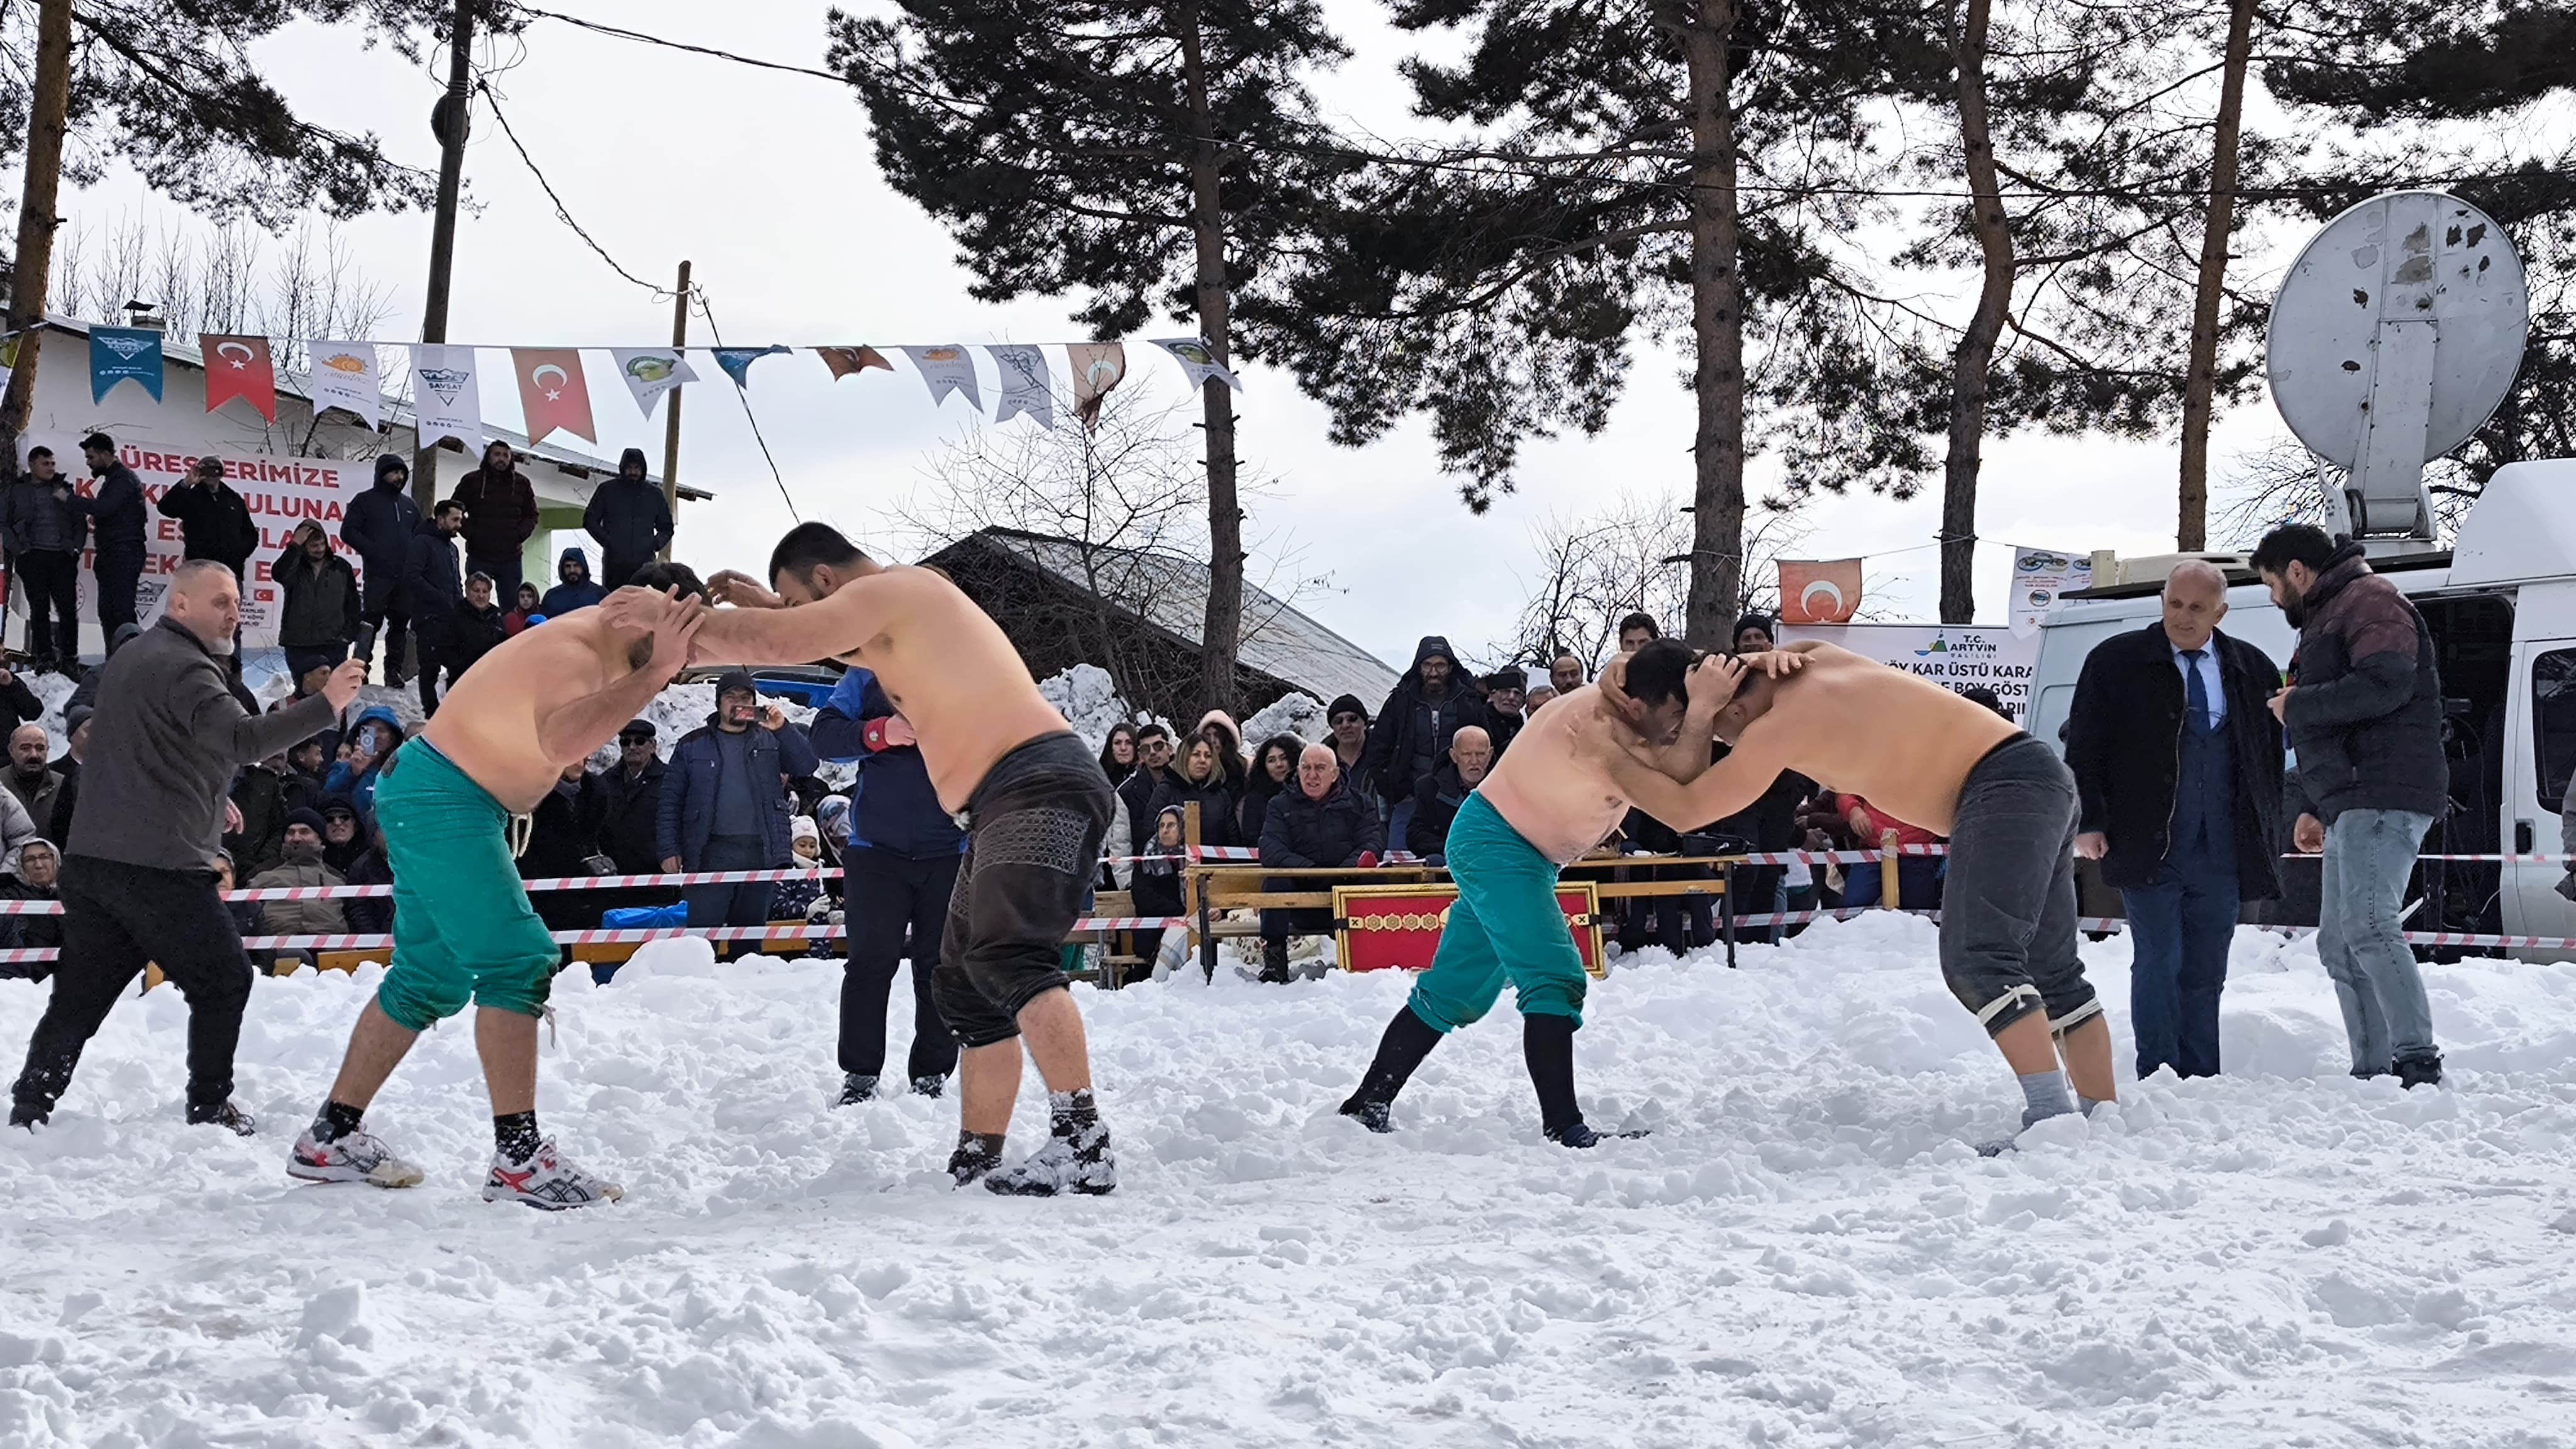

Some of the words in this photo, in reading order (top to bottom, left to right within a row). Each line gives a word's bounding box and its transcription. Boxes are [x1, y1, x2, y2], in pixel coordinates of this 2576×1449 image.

[243, 492, 344, 522] ULUNA
[1963, 635, 1985, 643] T.C.
[1913, 663, 1945, 676] KAR
[1948, 661, 1989, 677] ÜSTÜ
